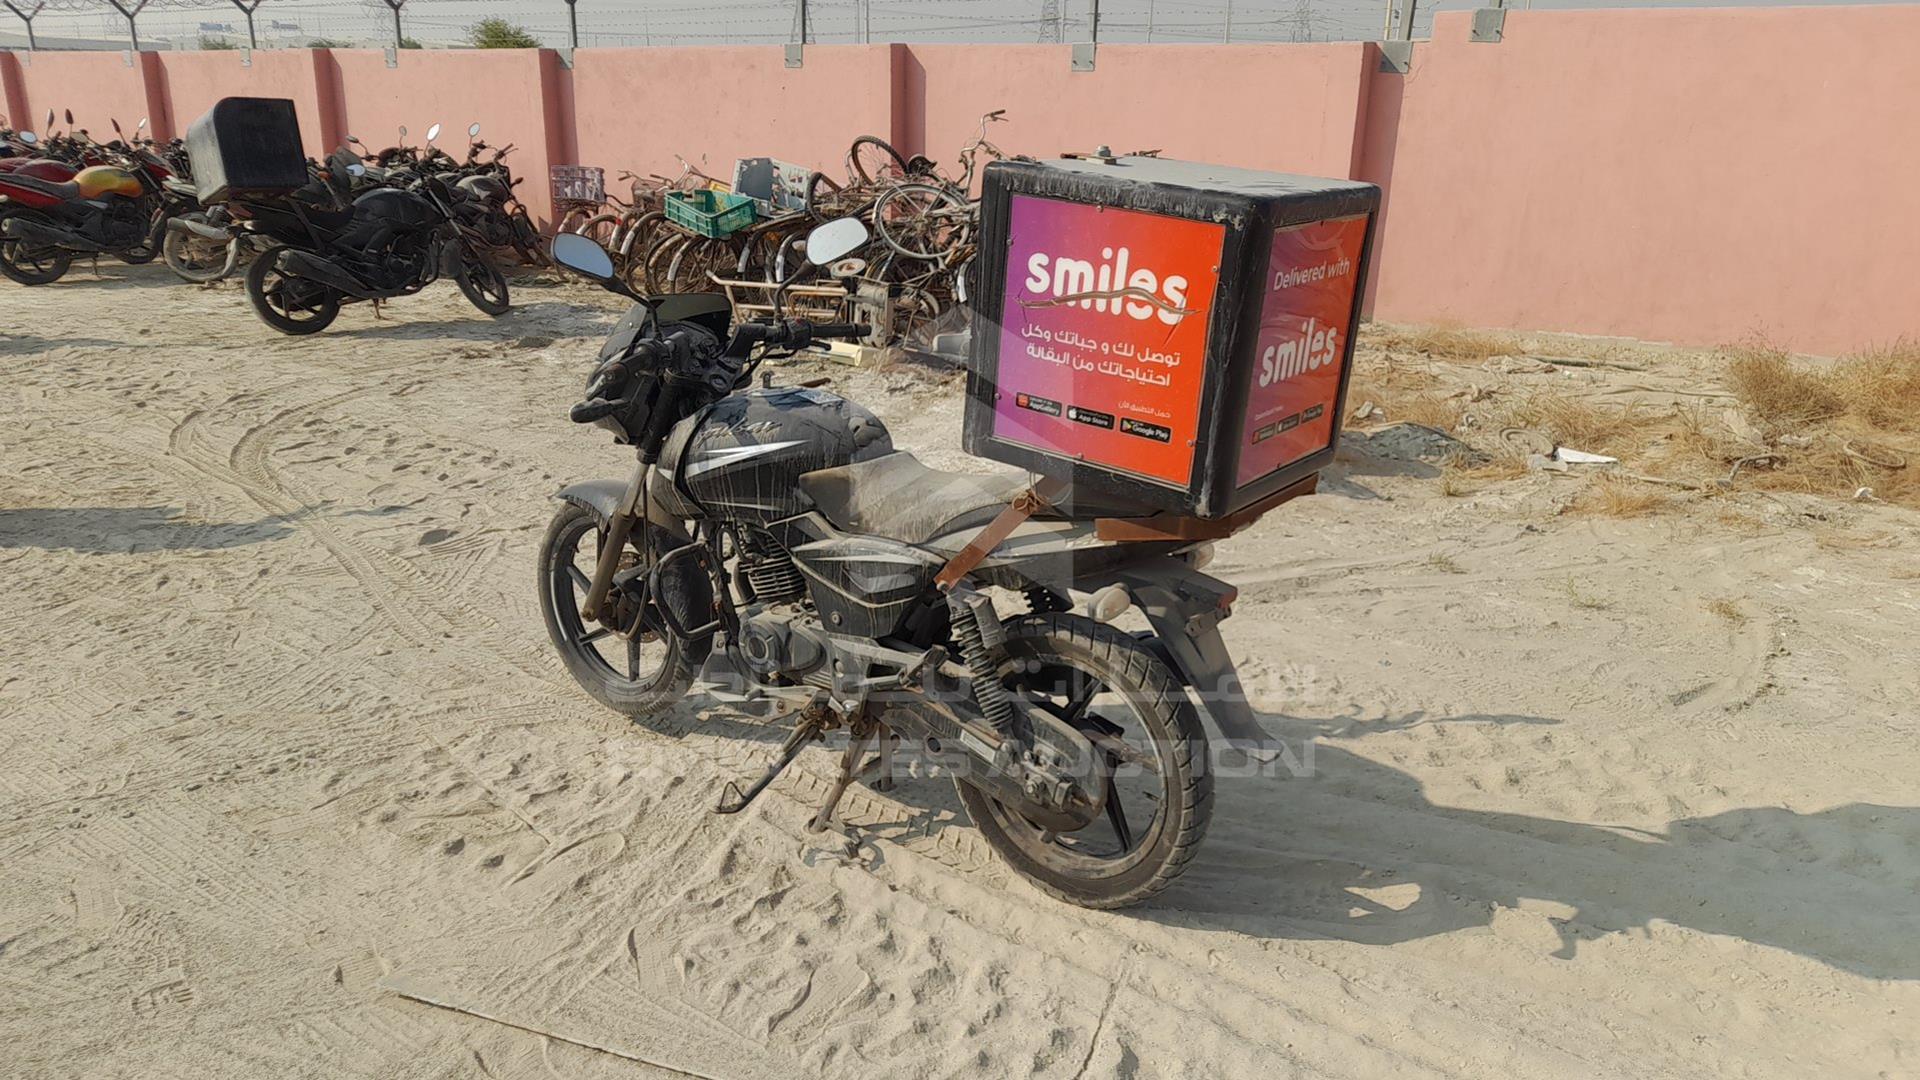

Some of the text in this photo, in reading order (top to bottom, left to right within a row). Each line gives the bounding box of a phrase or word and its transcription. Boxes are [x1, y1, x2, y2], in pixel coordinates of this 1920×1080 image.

[1273, 257, 1350, 291] Delivered with
[1025, 247, 1188, 325] smiles
[1021, 323, 1052, 342] وكل
[1112, 342, 1135, 357] لك
[1137, 347, 1181, 368] توصل
[1259, 316, 1337, 387] smiles
[1026, 342, 1171, 387] احتياجاتك من البقالة
[1078, 414, 1091, 423] App
[1091, 416, 1108, 427] Store
[1132, 424, 1169, 440] Google Play
